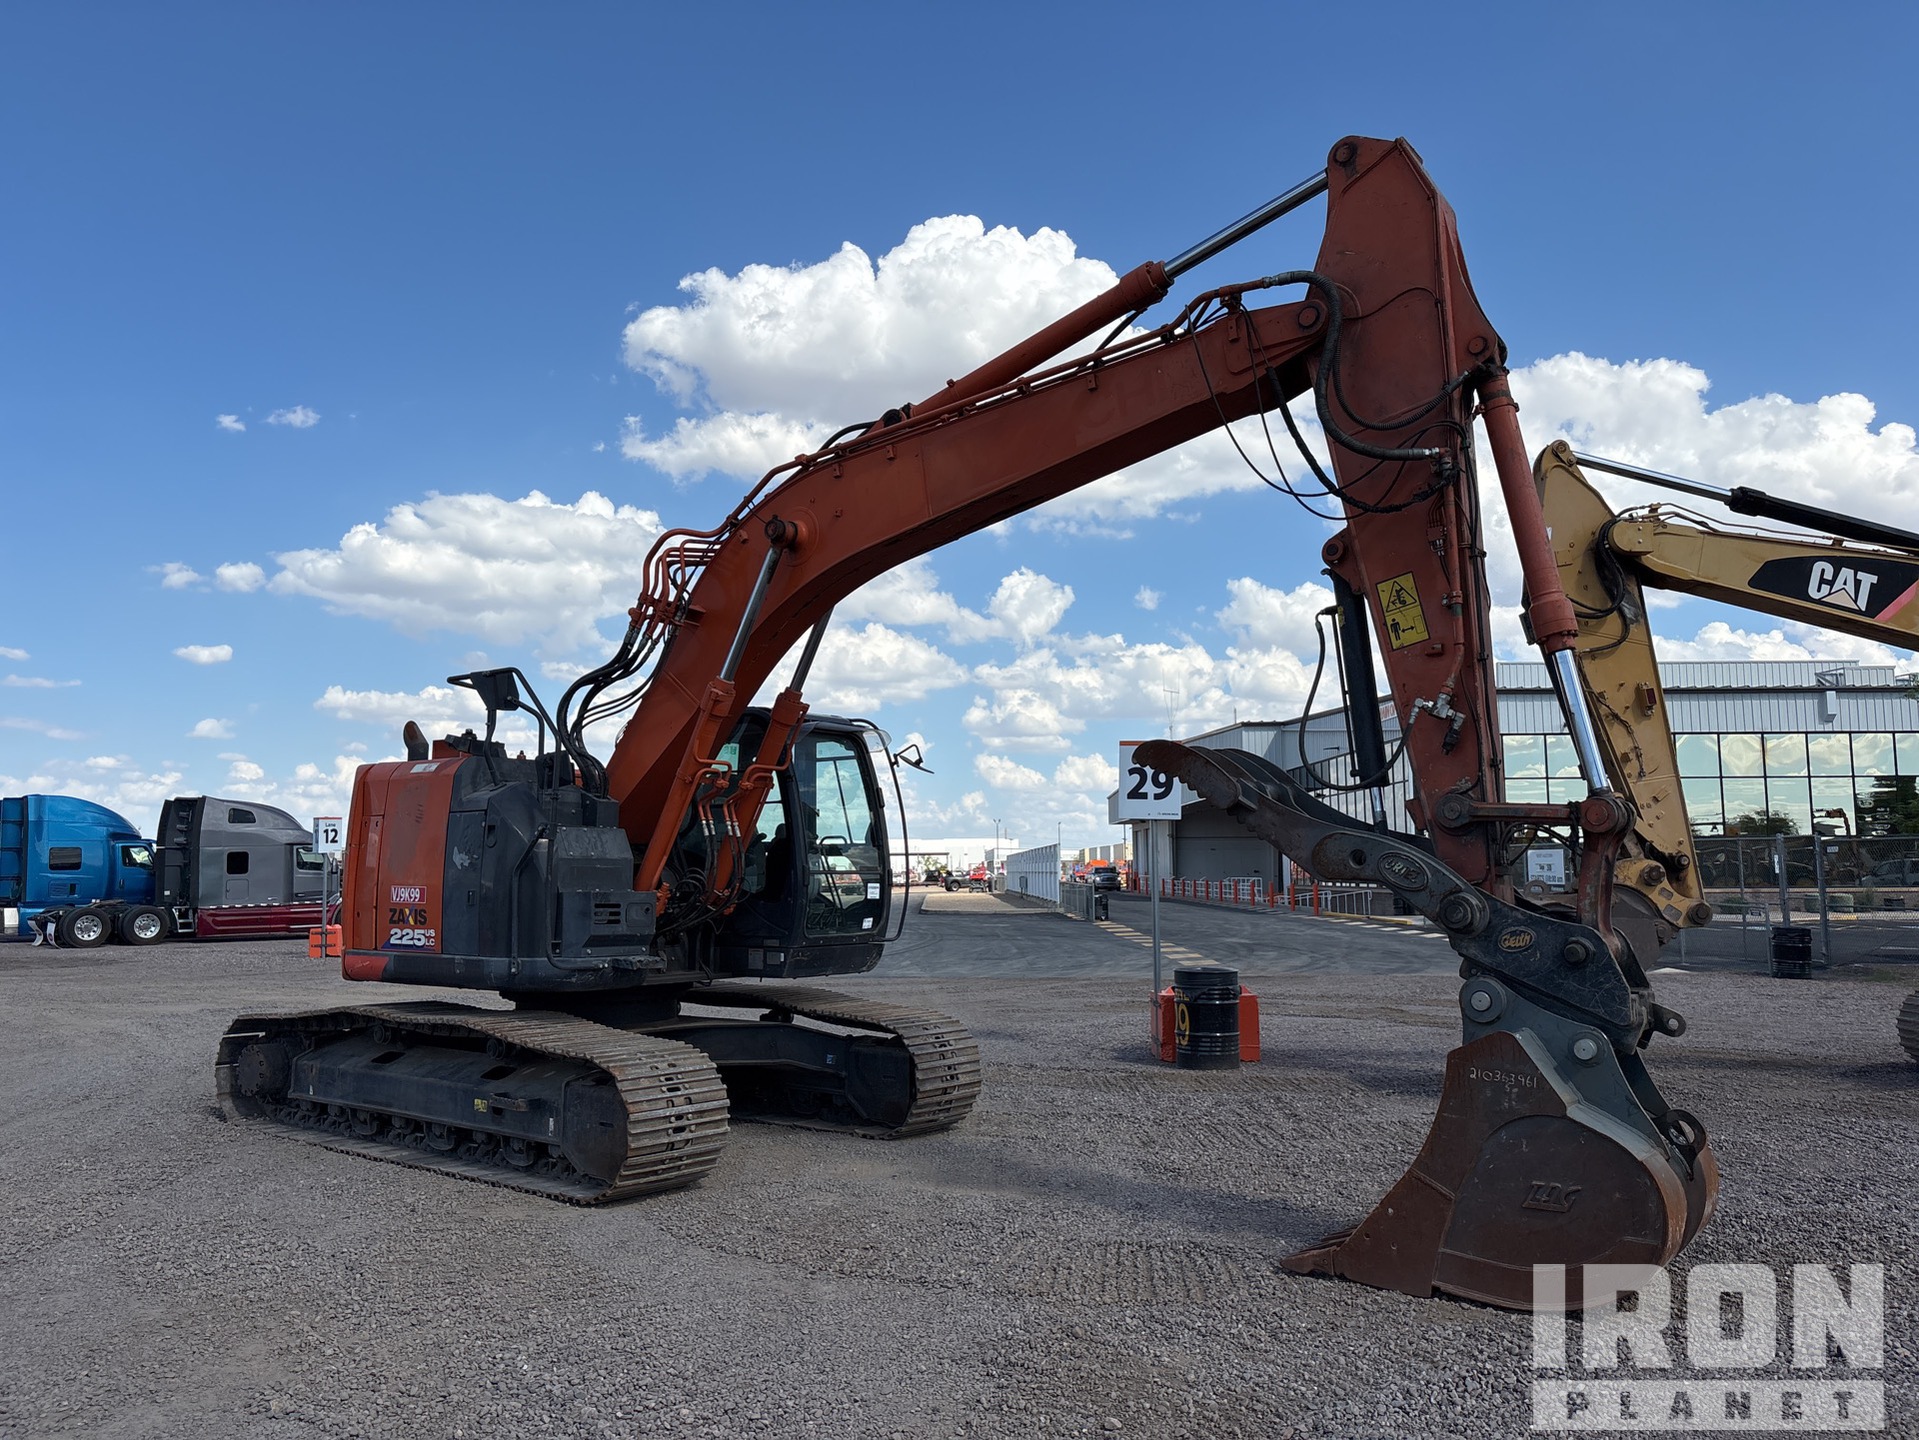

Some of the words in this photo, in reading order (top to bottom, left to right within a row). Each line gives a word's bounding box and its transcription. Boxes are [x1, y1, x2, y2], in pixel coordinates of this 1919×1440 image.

[1808, 561, 1878, 611] CAT
[1127, 767, 1174, 800] 29
[323, 828, 338, 843] 12
[392, 887, 420, 902] VJ9K99
[389, 904, 427, 925] ZAXIS
[390, 928, 425, 946] 225
[425, 929, 435, 937] US
[425, 938, 435, 946] LC
